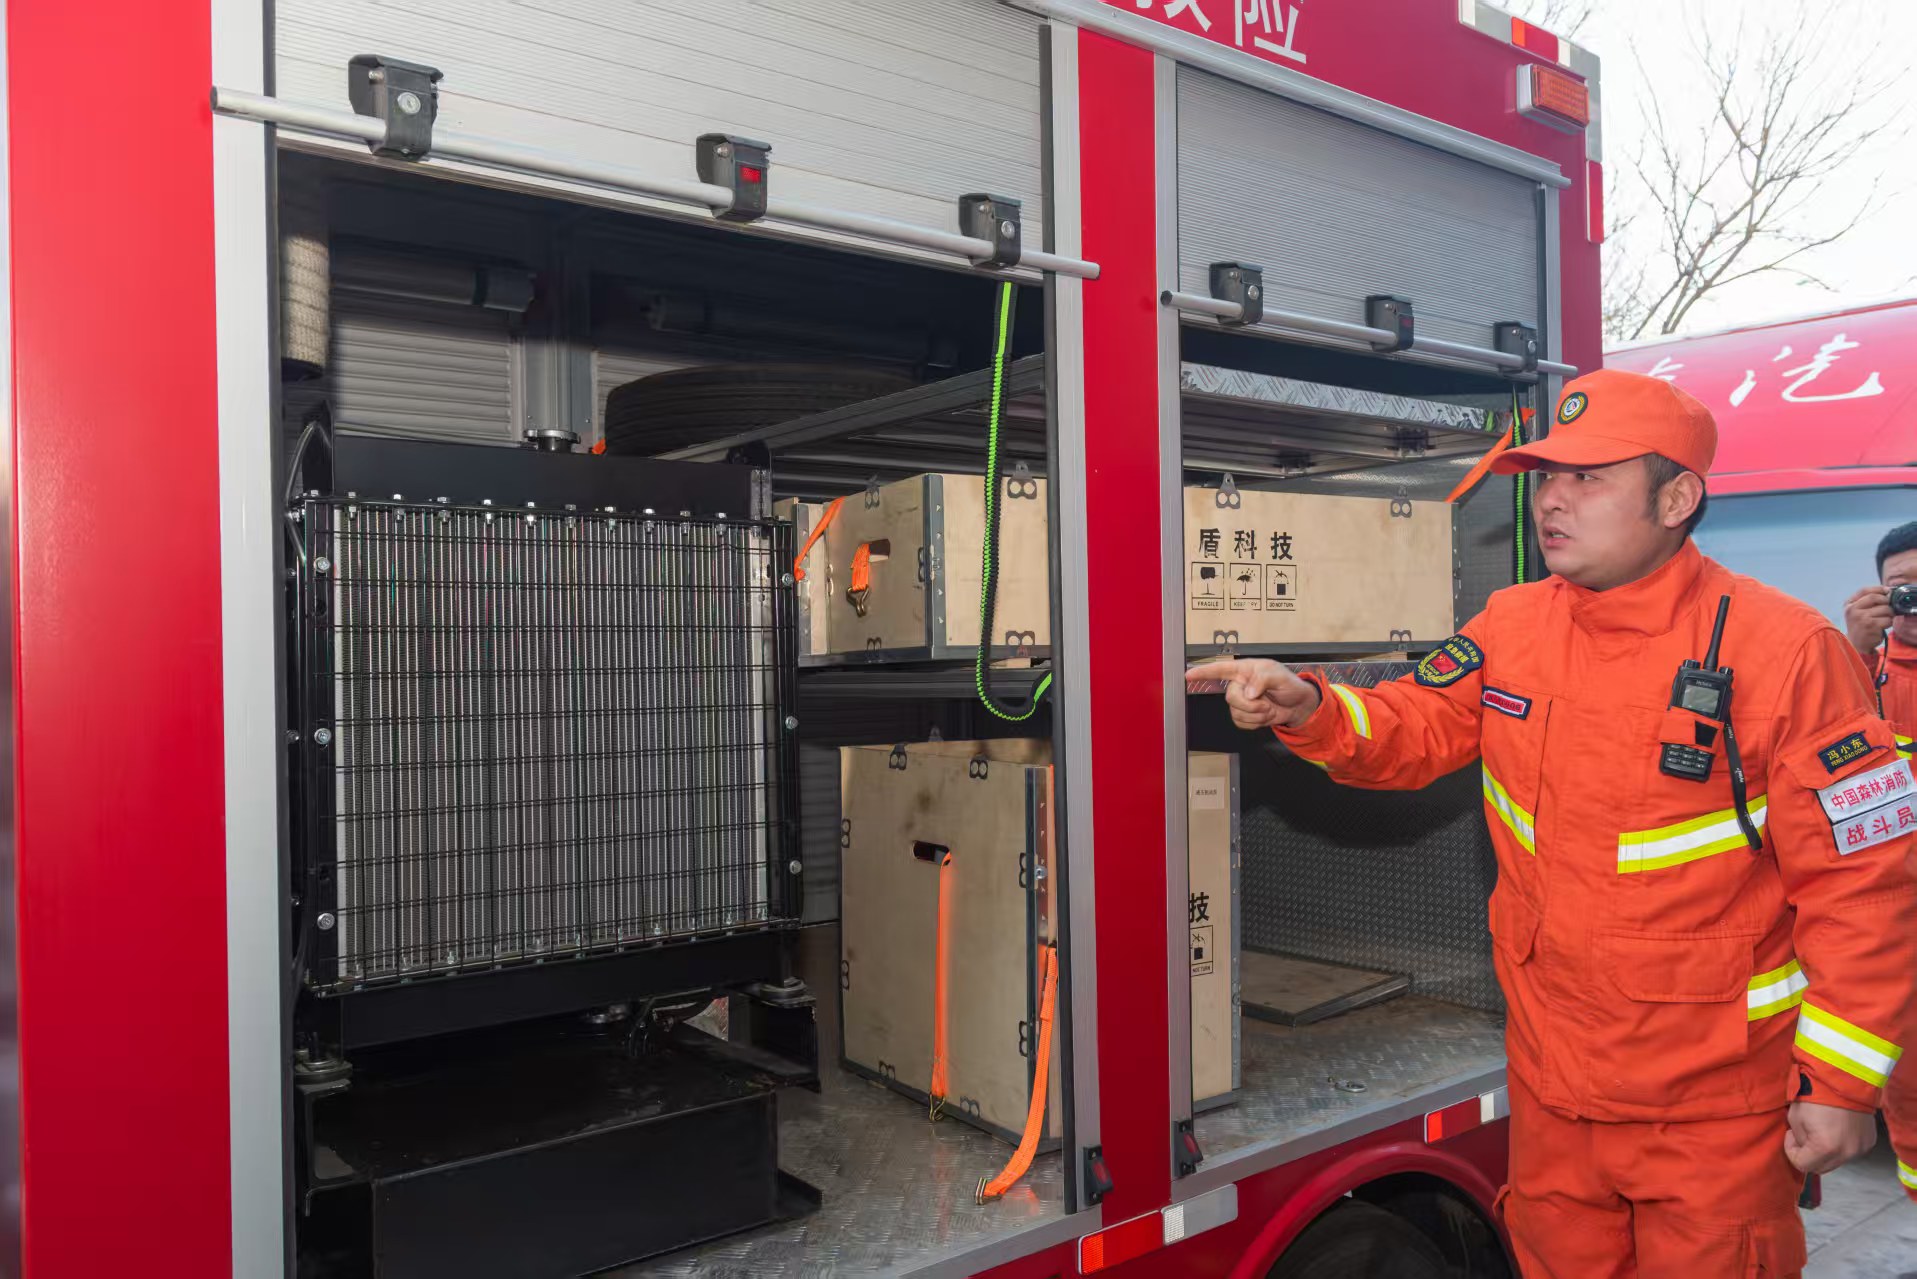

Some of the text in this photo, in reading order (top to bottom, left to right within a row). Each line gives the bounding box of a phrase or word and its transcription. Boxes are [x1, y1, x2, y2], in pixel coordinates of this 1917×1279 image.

[1198, 527, 1294, 561] 盾科技
[1827, 738, 1863, 761] 冯小东
[1831, 769, 1908, 811] 中国森林消防
[1846, 805, 1917, 846] 战斗员
[1189, 891, 1210, 923] 技
